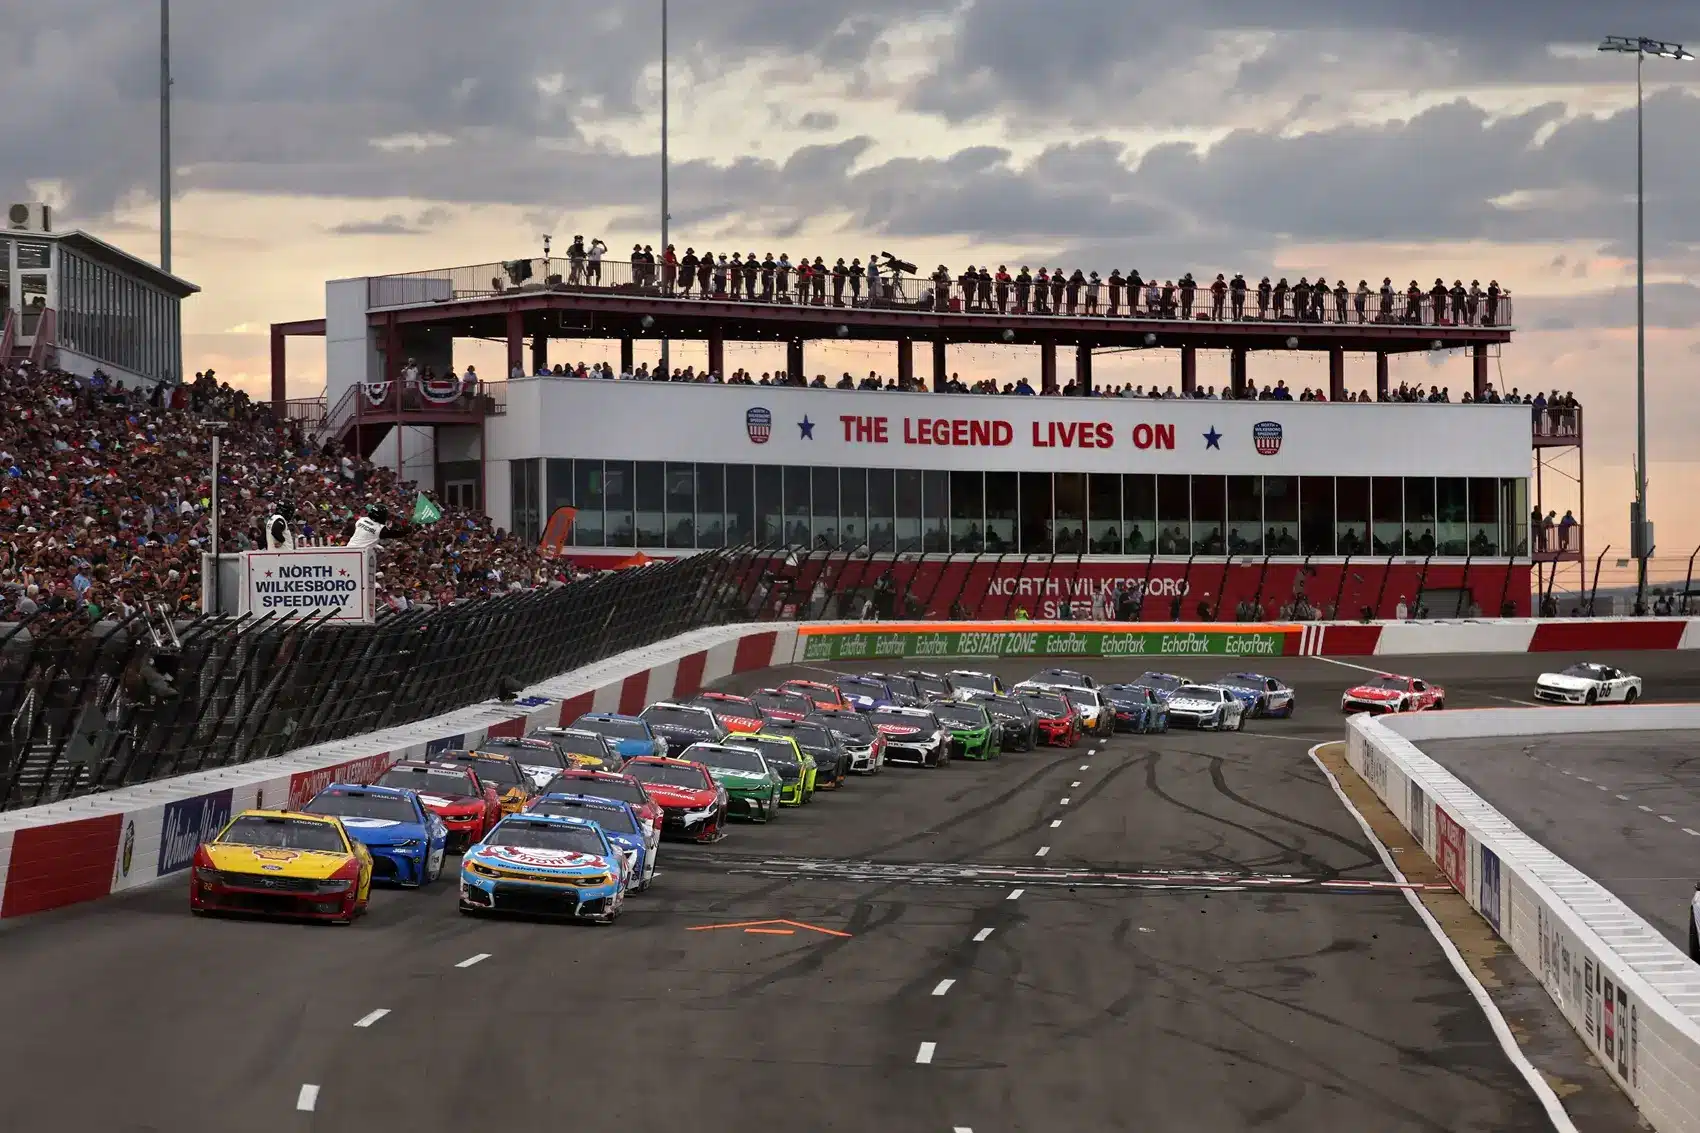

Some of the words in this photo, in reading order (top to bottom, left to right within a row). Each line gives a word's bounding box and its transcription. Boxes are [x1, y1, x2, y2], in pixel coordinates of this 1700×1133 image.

[840, 415, 888, 443] THE
[904, 418, 1012, 446] LEGEND
[1032, 421, 1113, 448] LIVES
[1133, 424, 1175, 449] ON
[279, 566, 332, 577] NORTH
[256, 580, 356, 592] WILKESBORO
[988, 578, 1059, 595] NORTH
[263, 594, 349, 607] SPEEDWAY
[916, 633, 947, 654] EchoPark
[957, 633, 1004, 653] RESTART
[1006, 632, 1038, 653] ZONE
[1047, 633, 1088, 652] EchoPark
[1101, 633, 1146, 652] EchoPark
[1161, 634, 1209, 652] EchoPark
[1225, 634, 1274, 653] EchoPark
[1600, 683, 1613, 697] 66
[292, 819, 323, 827] LOGANO
[498, 863, 582, 875] WeatherTech.com
[204, 883, 213, 891] 22
